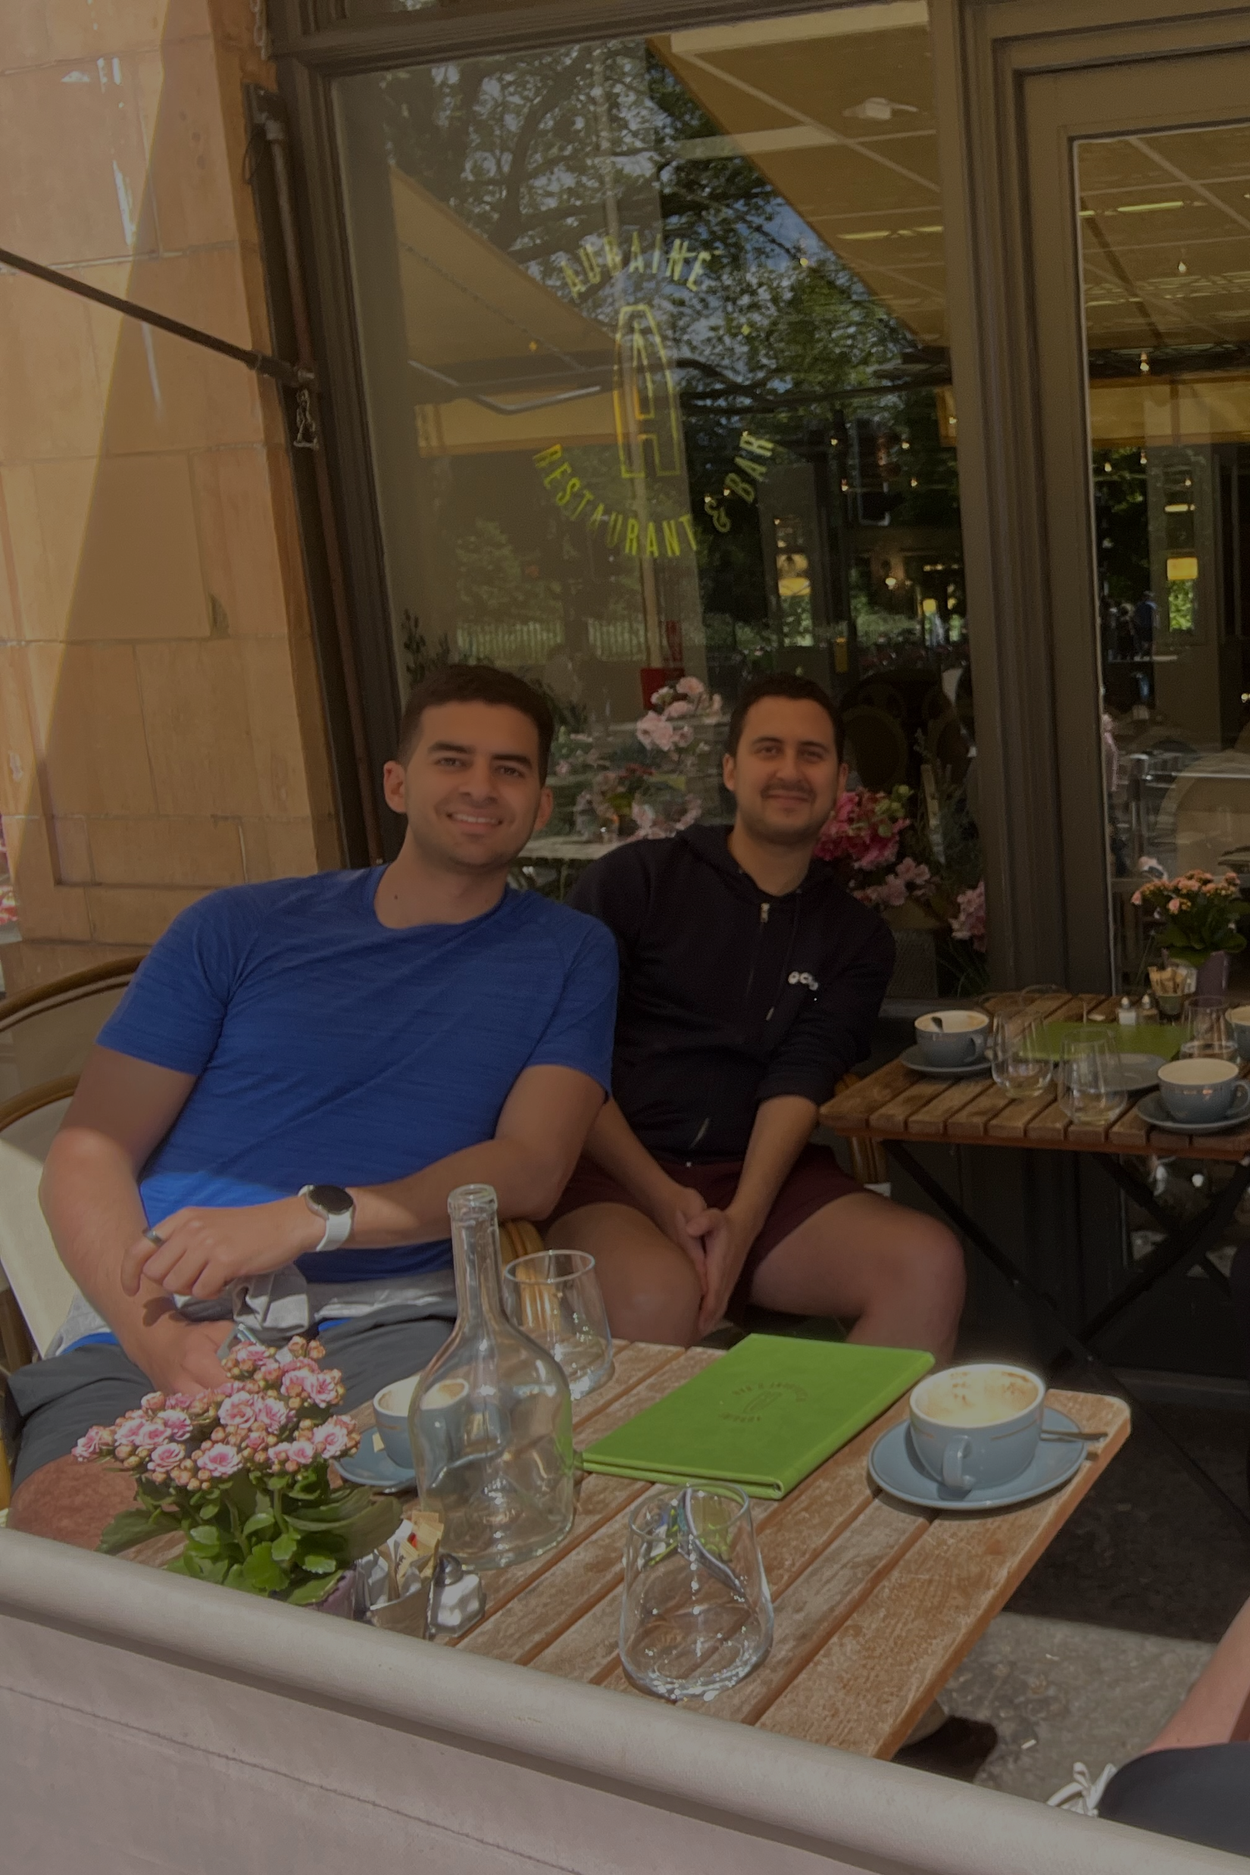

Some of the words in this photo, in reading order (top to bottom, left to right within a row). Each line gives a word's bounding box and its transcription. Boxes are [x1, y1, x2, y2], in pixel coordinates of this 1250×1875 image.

[560, 231, 712, 299] AUBAINE
[533, 444, 698, 557] RESTAURANT
[704, 498, 732, 533] &
[724, 433, 775, 504] BAR
